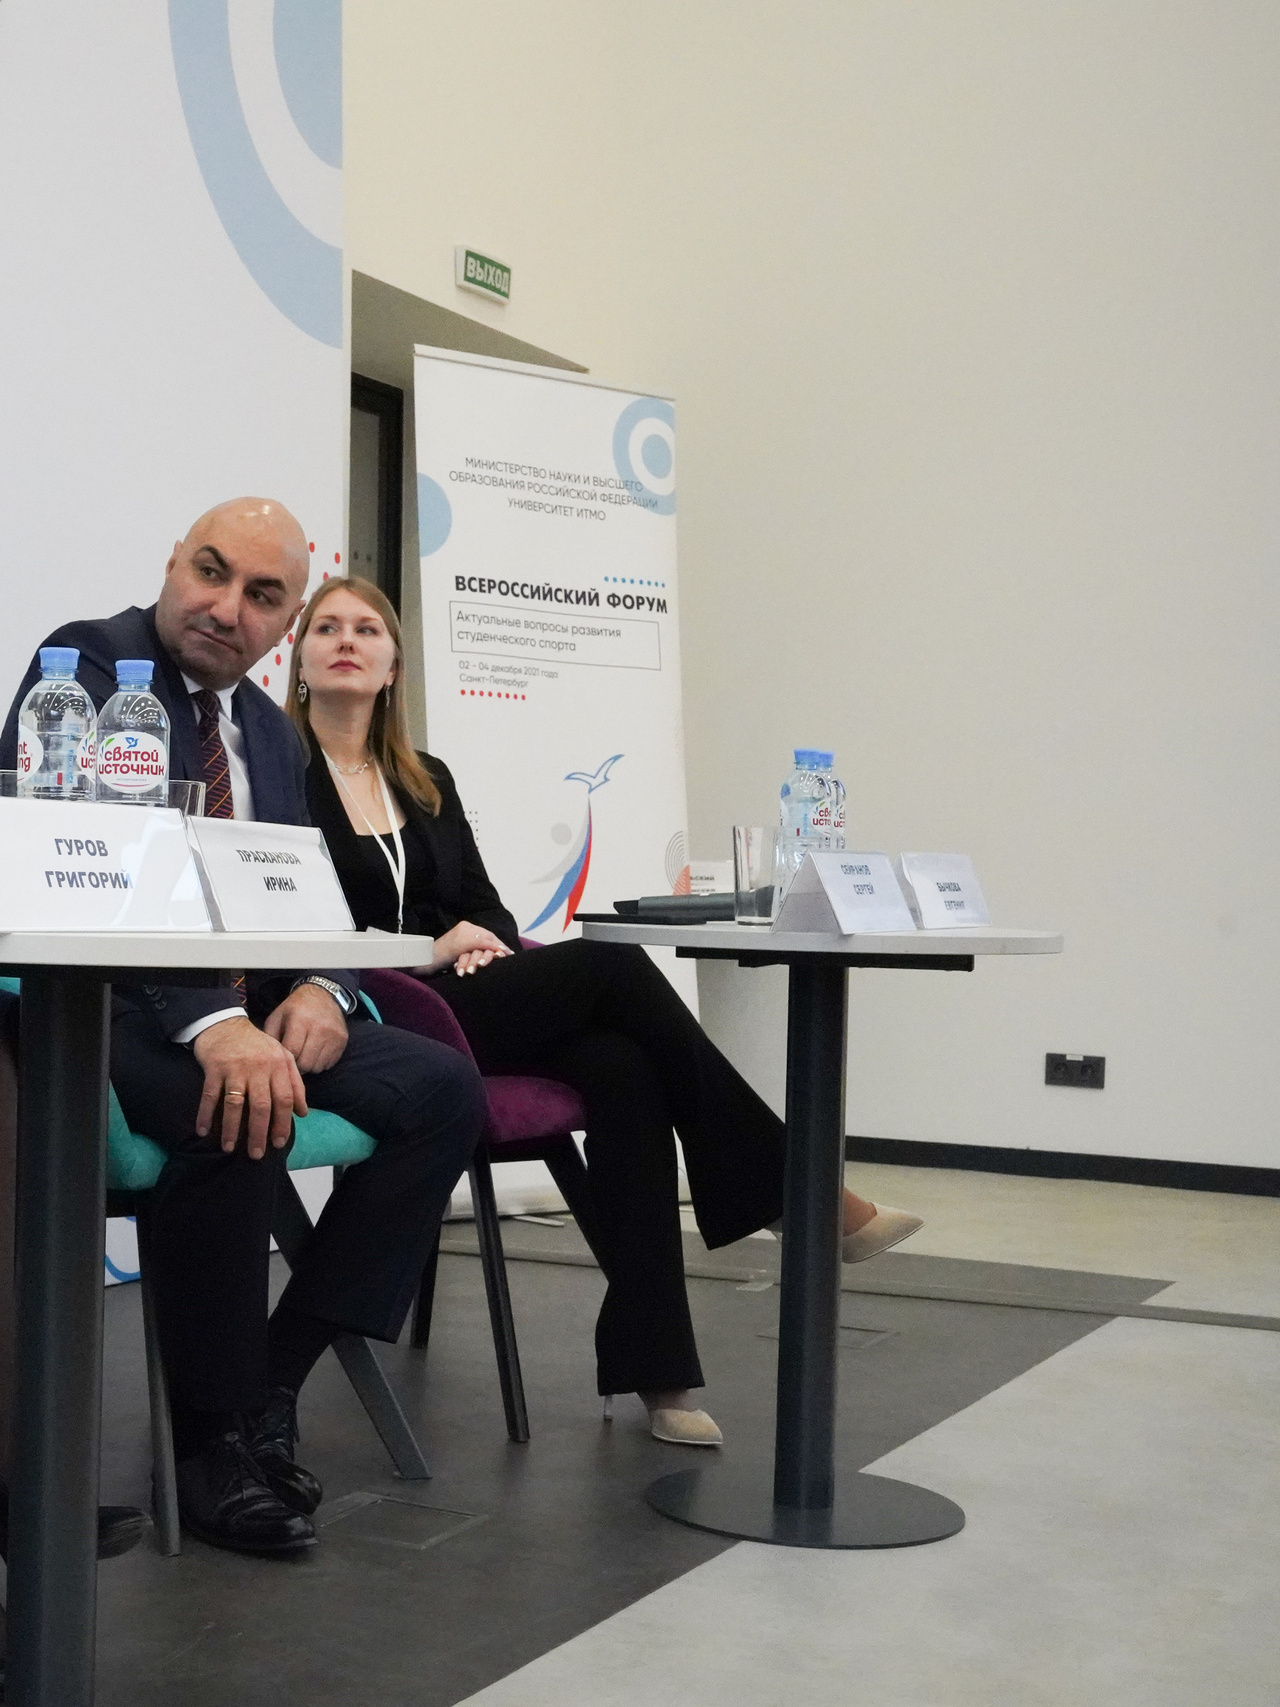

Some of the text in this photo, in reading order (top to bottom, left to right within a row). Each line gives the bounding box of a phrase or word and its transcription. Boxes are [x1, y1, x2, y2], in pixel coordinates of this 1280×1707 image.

[466, 255, 510, 294] ВЫХОД
[465, 457, 644, 492] МИНИСТЕРСТВО НАУКИ И ВЫСШЕГО
[449, 470, 659, 509] ОБРАЗОВАНИЯ РОССИЙСКОЙ ФЕДЕРАЦИИ
[507, 497, 607, 521] УНИВЕРСИТЕТ ИТМО
[455, 575, 668, 614] ВСЕРОССИЙСКИЙ ФОРУМ
[457, 610, 622, 639] Актуальные вопросы развития
[457, 630, 576, 652] студенческого спорта
[459, 660, 470, 670] 02
[478, 661, 490, 671] 04
[491, 664, 522, 676] декабря
[459, 673, 529, 689] Санкт-Петербург
[54, 838, 109, 857] ГУРОВ
[235, 849, 302, 865] ПРАСКАНОВА
[45, 869, 133, 889] ГРИГОРИЙ
[263, 876, 298, 892] ИРИНА
[853, 882, 875, 895] СЕРГЕЙ
